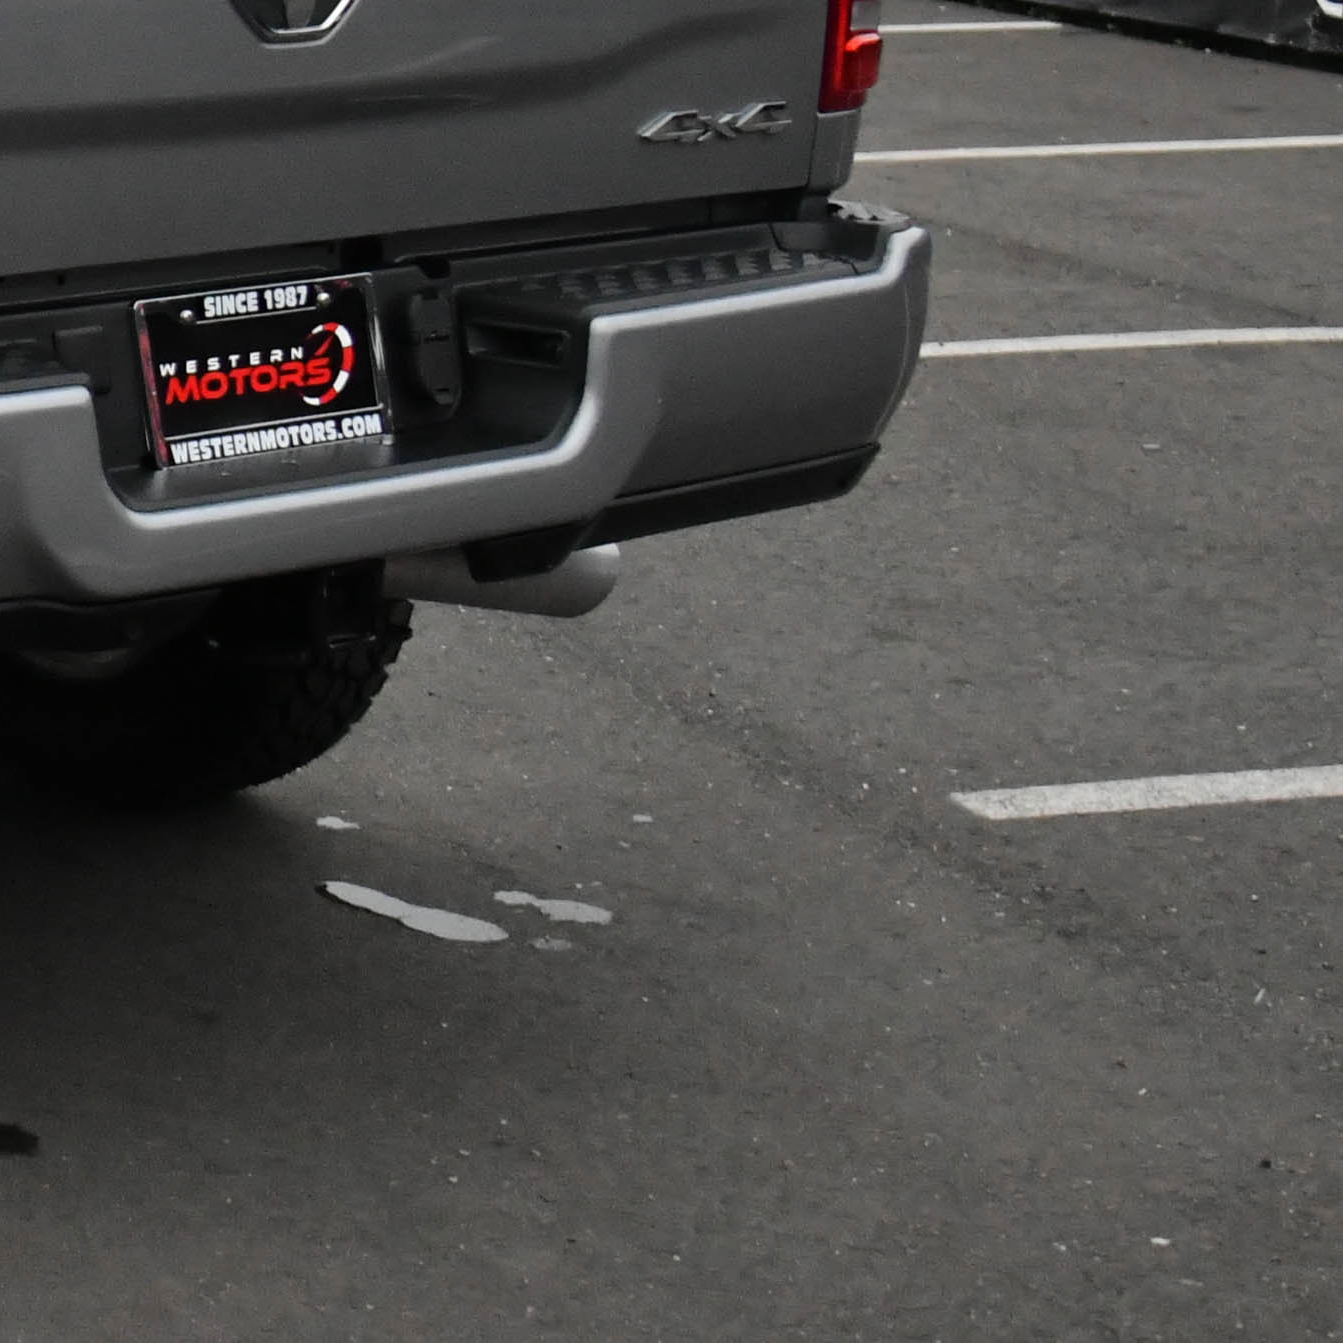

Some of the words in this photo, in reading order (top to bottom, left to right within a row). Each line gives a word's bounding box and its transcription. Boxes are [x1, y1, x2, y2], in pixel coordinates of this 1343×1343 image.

[203, 290, 259, 318] SINCE
[264, 285, 308, 311] 1987
[159, 346, 303, 377] WESTERN
[165, 356, 333, 405] MOTORS
[170, 413, 383, 465] WESTERNMOTORS.COM
